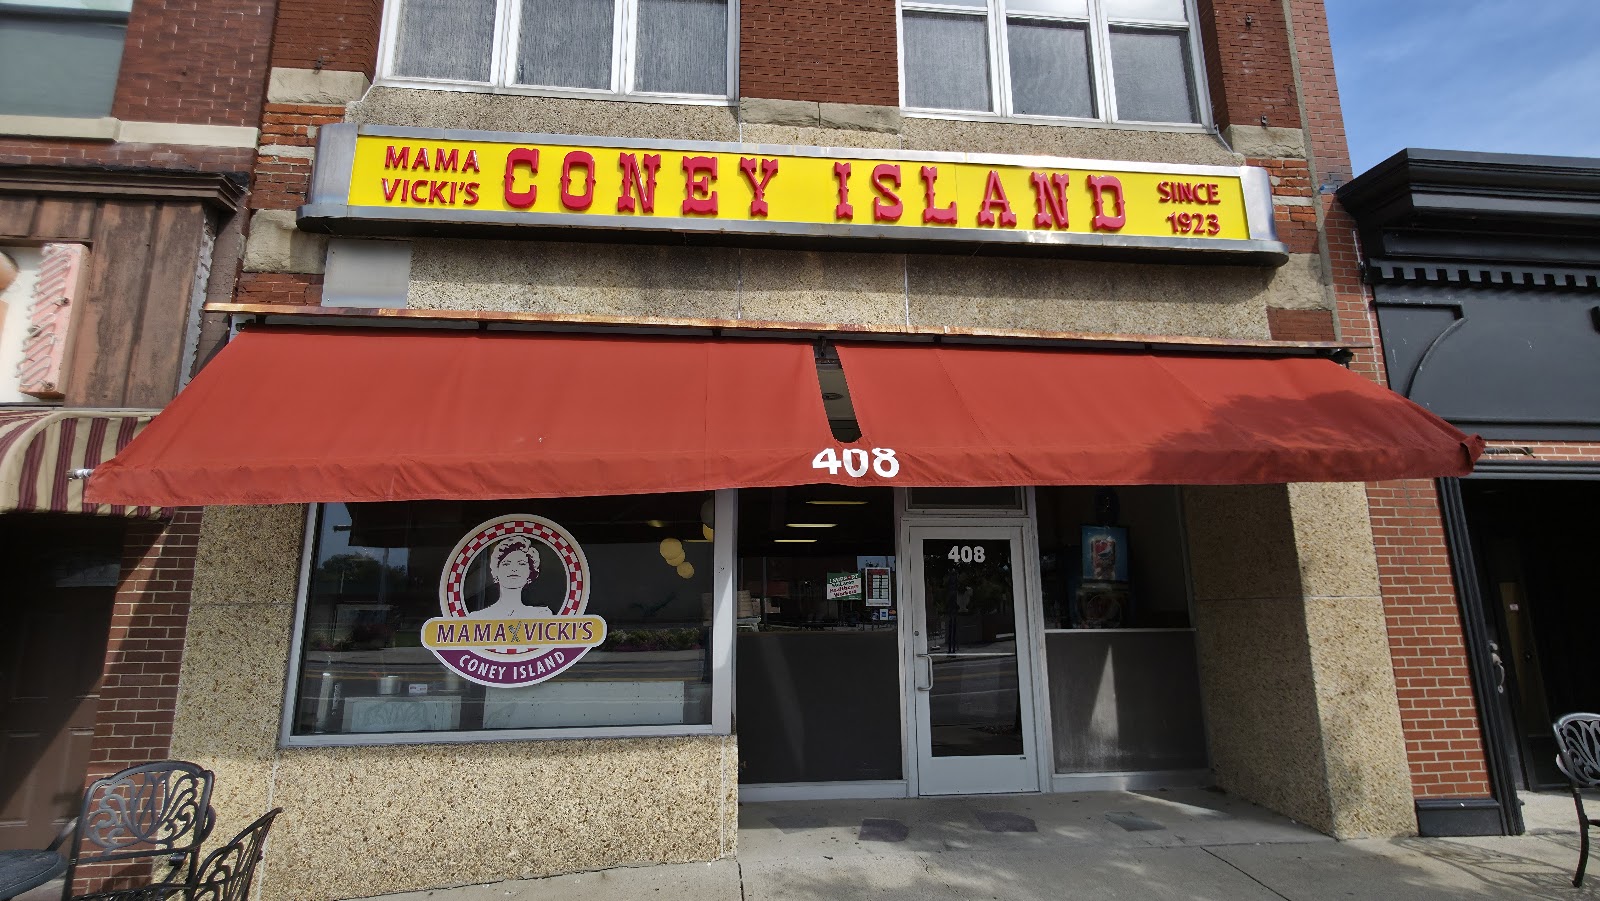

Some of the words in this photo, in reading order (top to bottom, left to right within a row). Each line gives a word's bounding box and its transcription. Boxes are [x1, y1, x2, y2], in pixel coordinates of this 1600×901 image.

[382, 146, 480, 173] MAMA
[381, 178, 480, 206] VICKI'S
[503, 147, 779, 217] CONEY
[833, 161, 1126, 231] ISLAND
[1156, 180, 1221, 205] SINCE
[1165, 211, 1221, 235] 1923
[812, 447, 900, 478] 408
[948, 545, 986, 563] 408
[436, 623, 507, 643] MAMA
[523, 621, 594, 642] VICKI'S
[459, 654, 507, 680] CONEY
[513, 651, 565, 680] ISLAND
